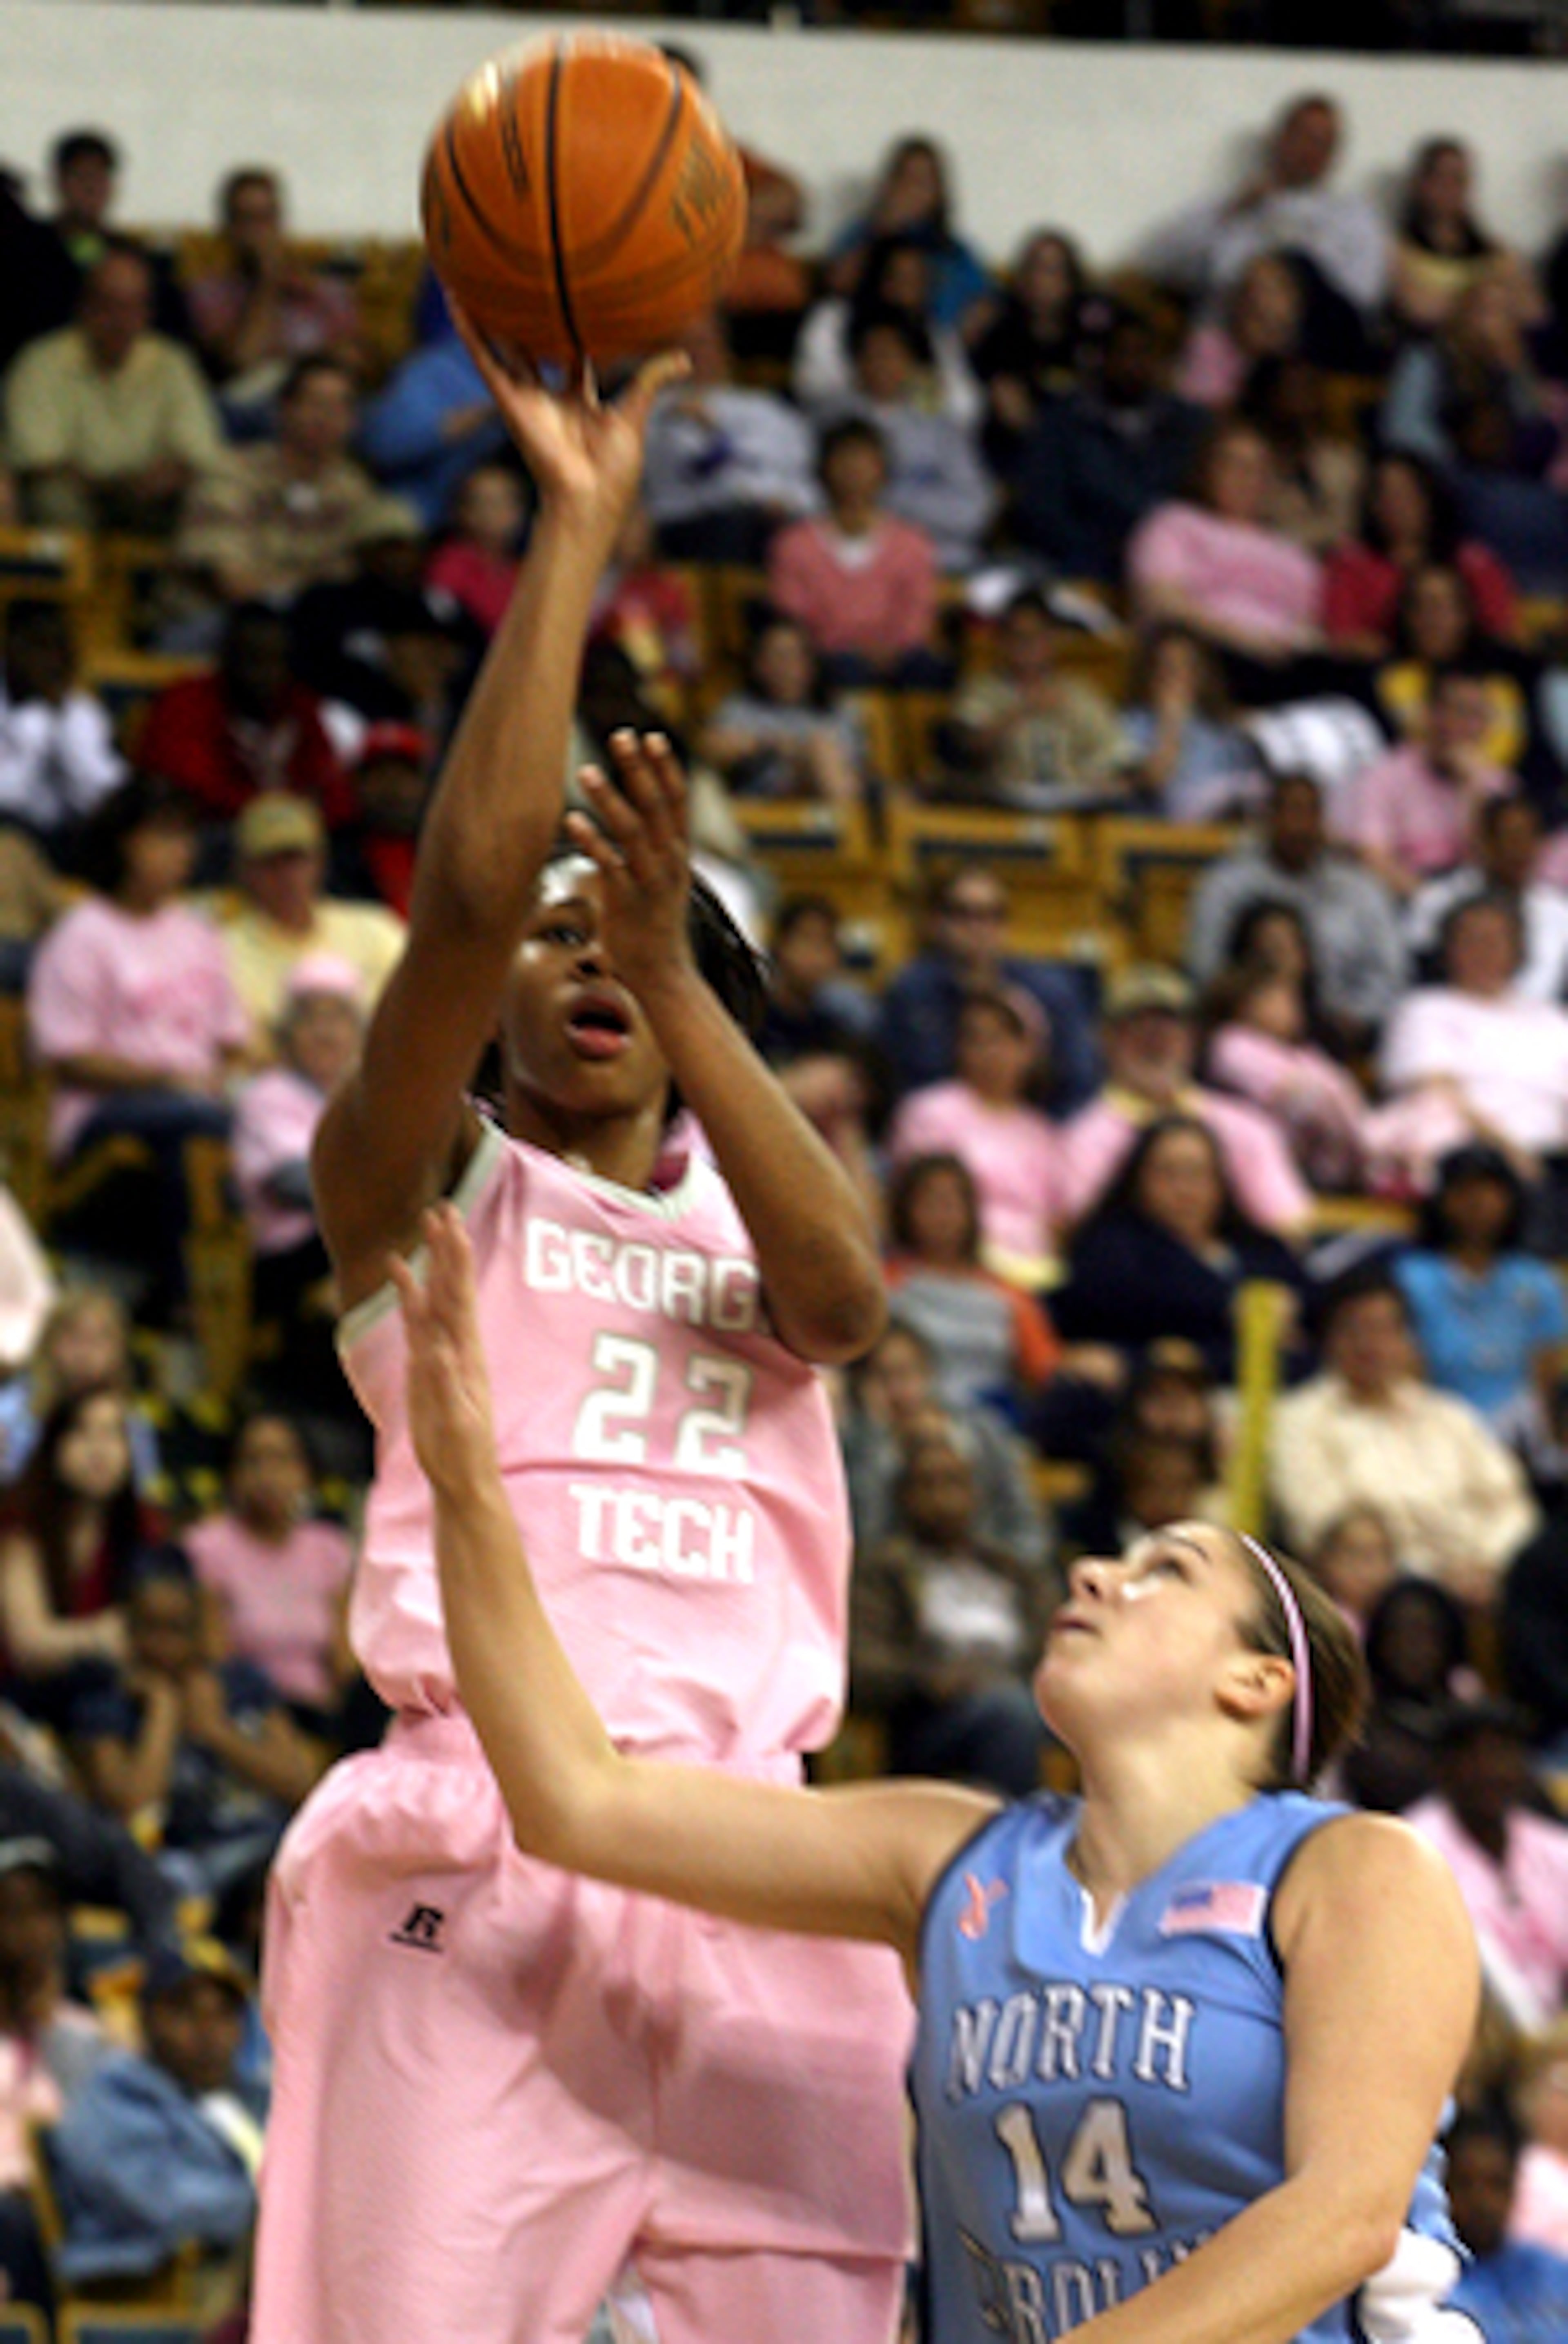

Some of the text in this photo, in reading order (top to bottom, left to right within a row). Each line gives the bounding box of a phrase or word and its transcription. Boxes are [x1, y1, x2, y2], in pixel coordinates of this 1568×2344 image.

[524, 1217, 763, 1332] GEORG
[572, 1330, 751, 1481] 22
[569, 1485, 754, 1584] TECH
[946, 1983, 1195, 2101] NORTH
[996, 2098, 1159, 2242] 14
